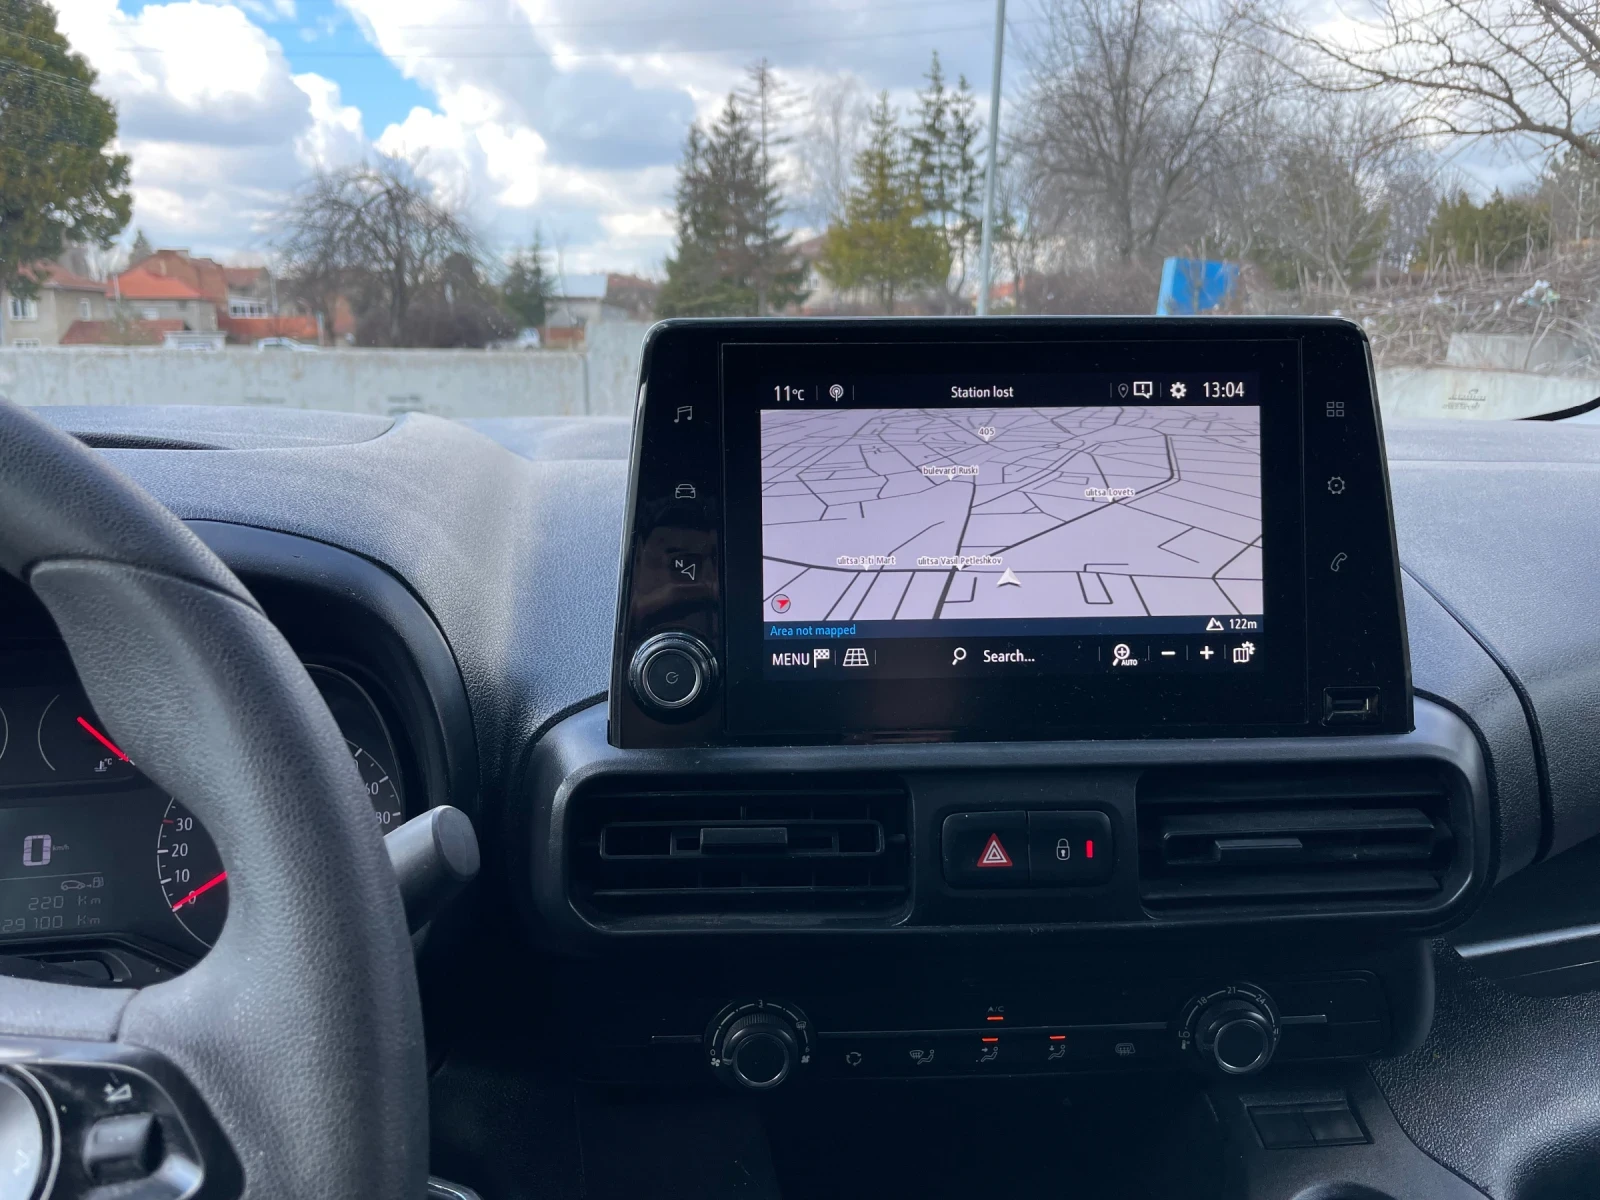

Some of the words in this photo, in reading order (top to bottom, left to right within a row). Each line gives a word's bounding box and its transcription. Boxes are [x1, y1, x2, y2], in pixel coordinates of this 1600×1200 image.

[951, 386, 990, 398] Station
[993, 385, 1014, 398] lost
[1203, 381, 1245, 398] 13:04
[979, 427, 995, 436] 405
[923, 465, 956, 475] bulevard
[959, 465, 978, 474] Ruski
[1085, 488, 1107, 497] ulitsa
[1109, 487, 1134, 497] Lovets
[837, 557, 859, 565] ulitsa
[876, 556, 895, 565] Mart
[918, 557, 939, 565] ulitsa
[940, 556, 958, 565] Vasil
[960, 556, 1002, 565] Petleshkov
[1229, 618, 1257, 629] 122m
[769, 625, 794, 636] Area
[796, 625, 813, 636] not
[815, 624, 856, 638] mapped
[772, 652, 810, 666] MENU
[983, 648, 1036, 663] Search...
[1120, 658, 1138, 666] AUTO
[175, 816, 193, 832] 30
[23, 834, 52, 867] 0
[171, 842, 188, 858] 20
[175, 868, 190, 883] 10
[28, 895, 64, 911] 220
[1227, 986, 1236, 994] 21
[1197, 996, 1208, 1006] 18
[1255, 993, 1267, 1005] 24
[987, 1005, 1005, 1013] A/C
